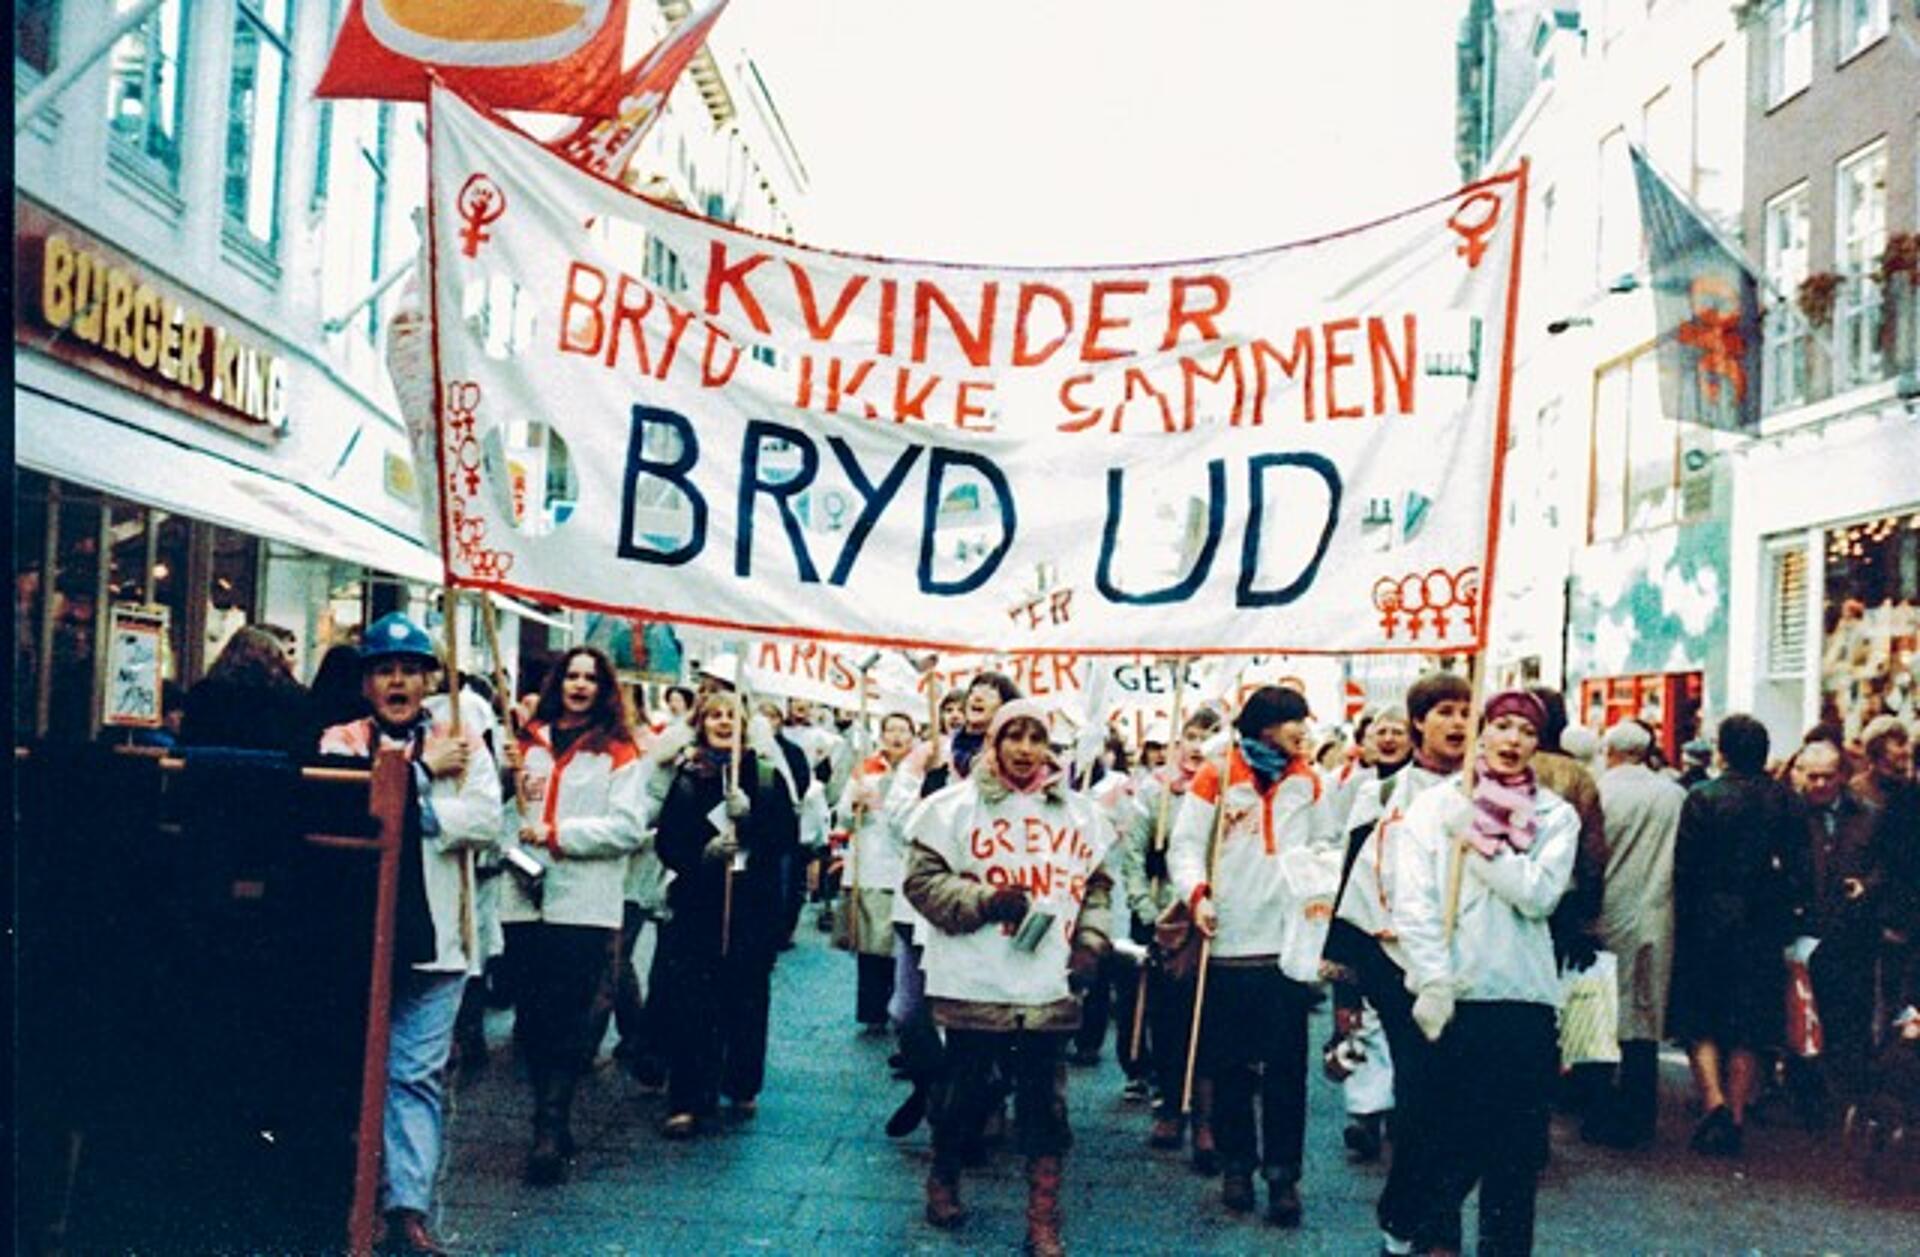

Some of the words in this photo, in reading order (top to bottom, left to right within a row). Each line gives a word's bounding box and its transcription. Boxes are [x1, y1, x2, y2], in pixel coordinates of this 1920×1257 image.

[42, 233, 204, 392] BURGER
[211, 326, 288, 427] KING
[558, 260, 742, 388] BRYD
[794, 354, 996, 432] IKKE
[1057, 313, 1417, 433] SAMMEN
[704, 239, 1231, 368] KVINDER
[617, 403, 1018, 597] BRYD
[1094, 451, 1343, 608] UD
